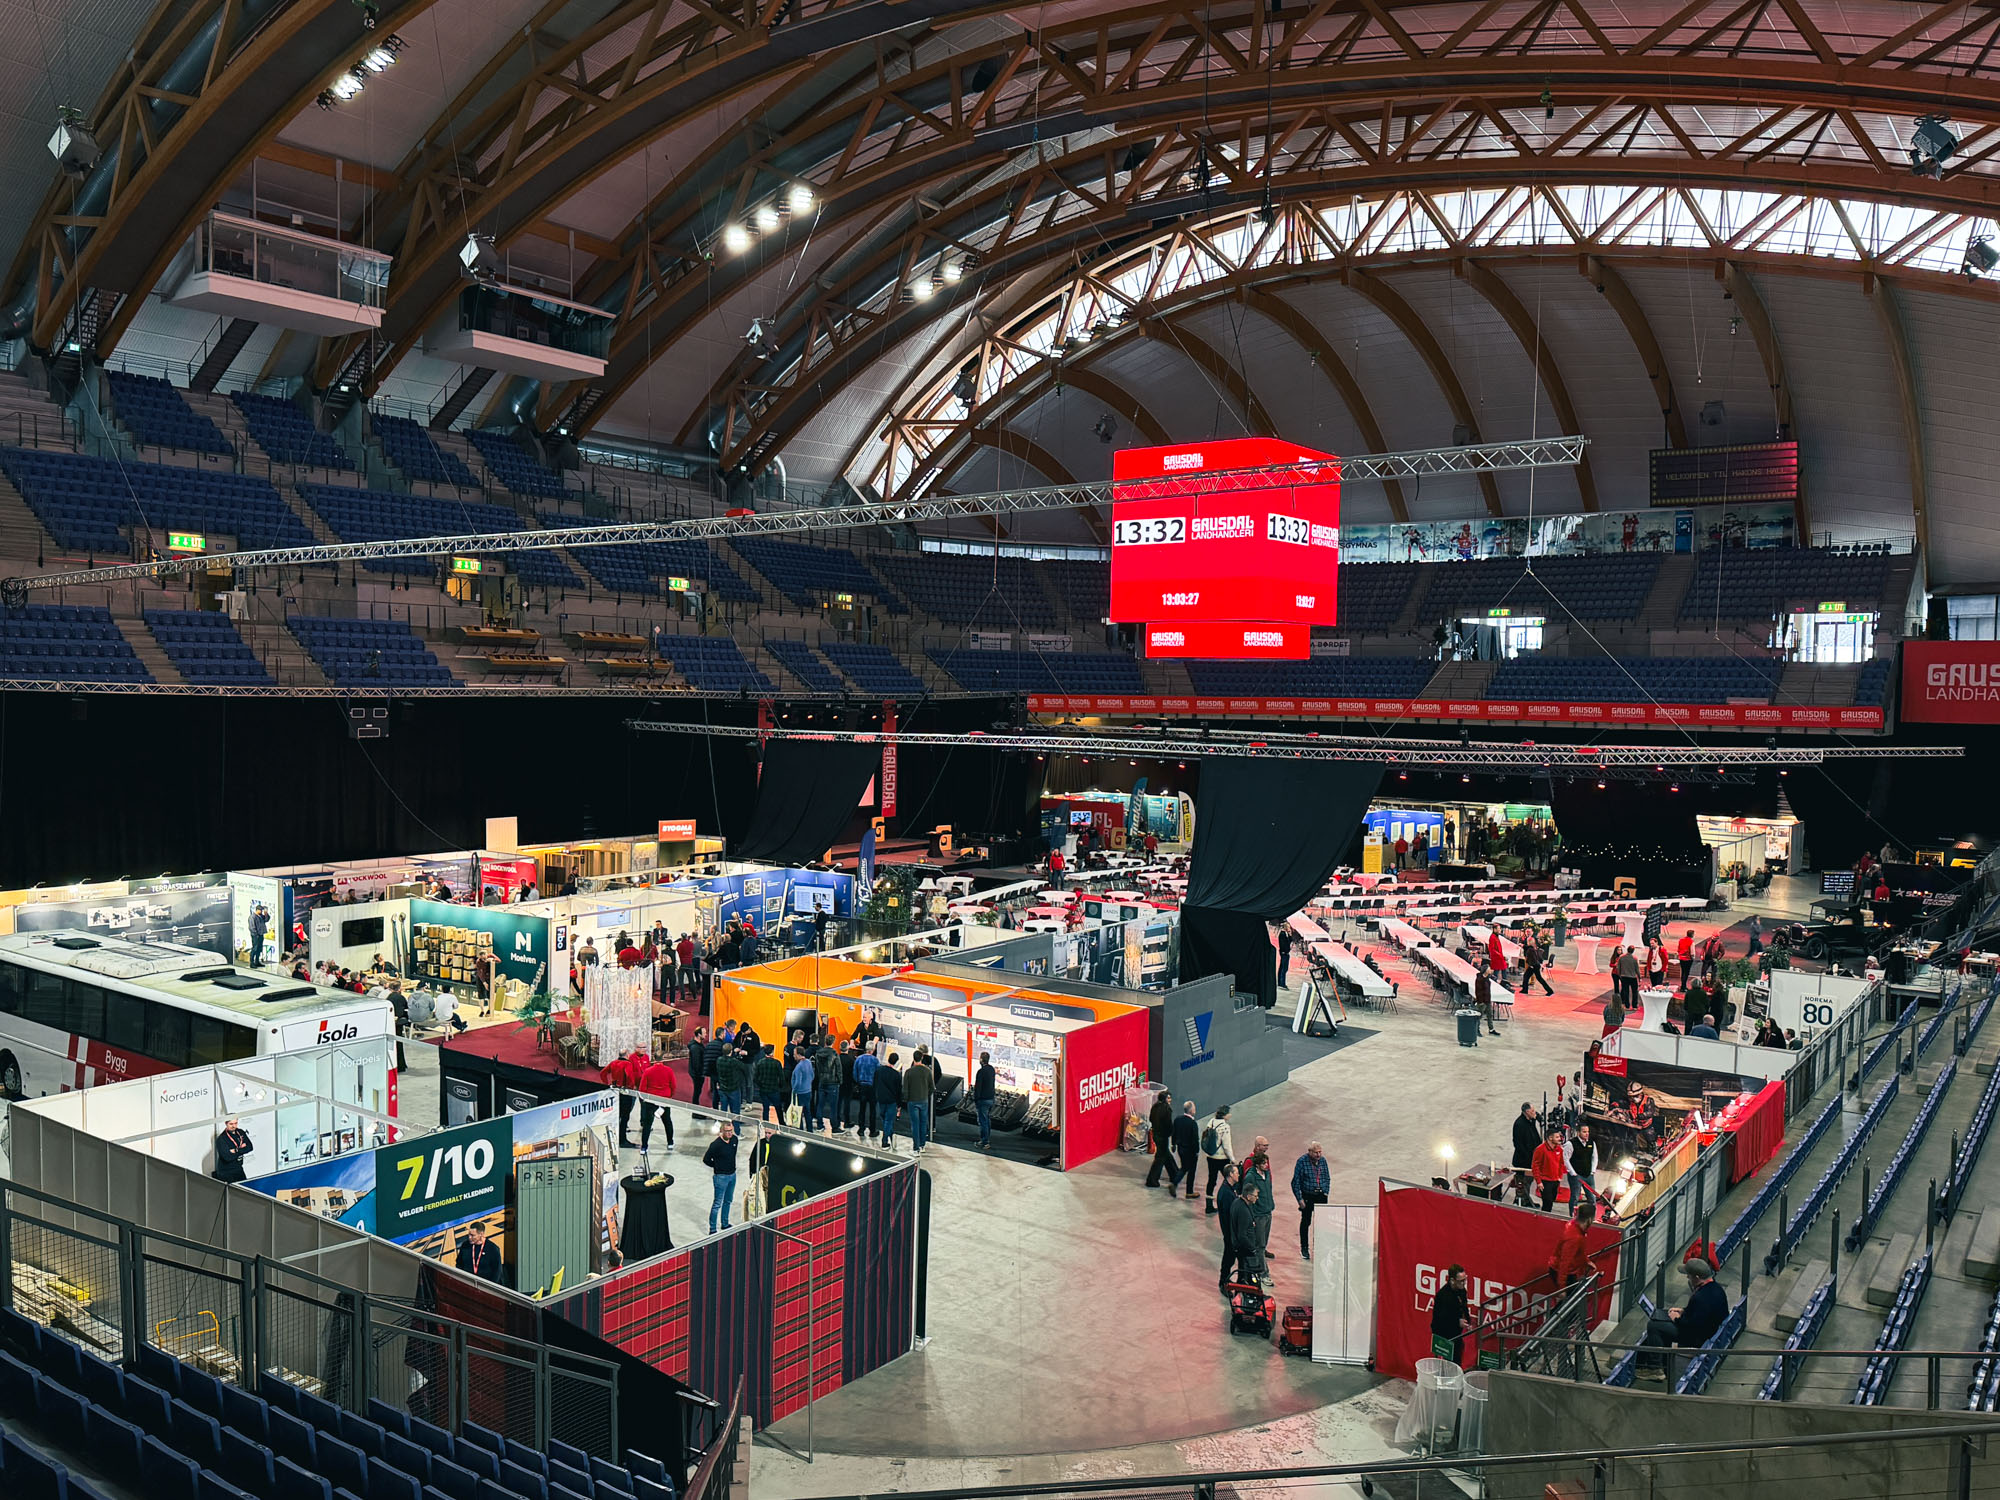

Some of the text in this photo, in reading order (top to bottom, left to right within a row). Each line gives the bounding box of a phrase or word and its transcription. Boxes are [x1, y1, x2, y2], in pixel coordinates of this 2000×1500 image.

[1163, 453, 1203, 465] GAUSDAL
[1191, 515, 1254, 532] GAUSDAL
[1269, 516, 1308, 544] 13:32
[1115, 519, 1185, 544] 13:32
[1191, 528, 1254, 540] LANDHANDLERI
[1162, 593, 1199, 605] 13:03:27
[1151, 632, 1185, 643] GAUSDAL
[1244, 632, 1283, 643] GAUSDAL
[1449, 704, 1479, 712] GAUSDAL
[1570, 706, 1602, 714] GAUSDAL
[1612, 707, 1645, 715] GAUSDAL
[1655, 708, 1689, 716] GAUSDAL
[1700, 709, 1734, 717] GAUSDAL
[1745, 710, 1781, 718] GAUSDAL
[1792, 710, 1830, 718] GAUSDAL
[1841, 711, 1879, 719] GAUSDAL
[885, 746, 896, 808] GAUSDAL
[1130, 788, 1145, 836] makita
[510, 952, 537, 965] Moelven
[1804, 996, 1833, 1004] NOREMA
[1803, 1003, 1833, 1026] 80
[316, 1020, 358, 1045] isola
[105, 1050, 127, 1074] Bygg
[339, 1053, 381, 1069] Nordpeis
[1079, 1061, 1137, 1101] GAUSDAL
[160, 1086, 208, 1104] Nordpeis
[571, 1096, 616, 1118] ULTIMALT
[396, 1138, 495, 1201] 7/10
[398, 1185, 494, 1219] VELGER FERDIGMALT KLEDNING
